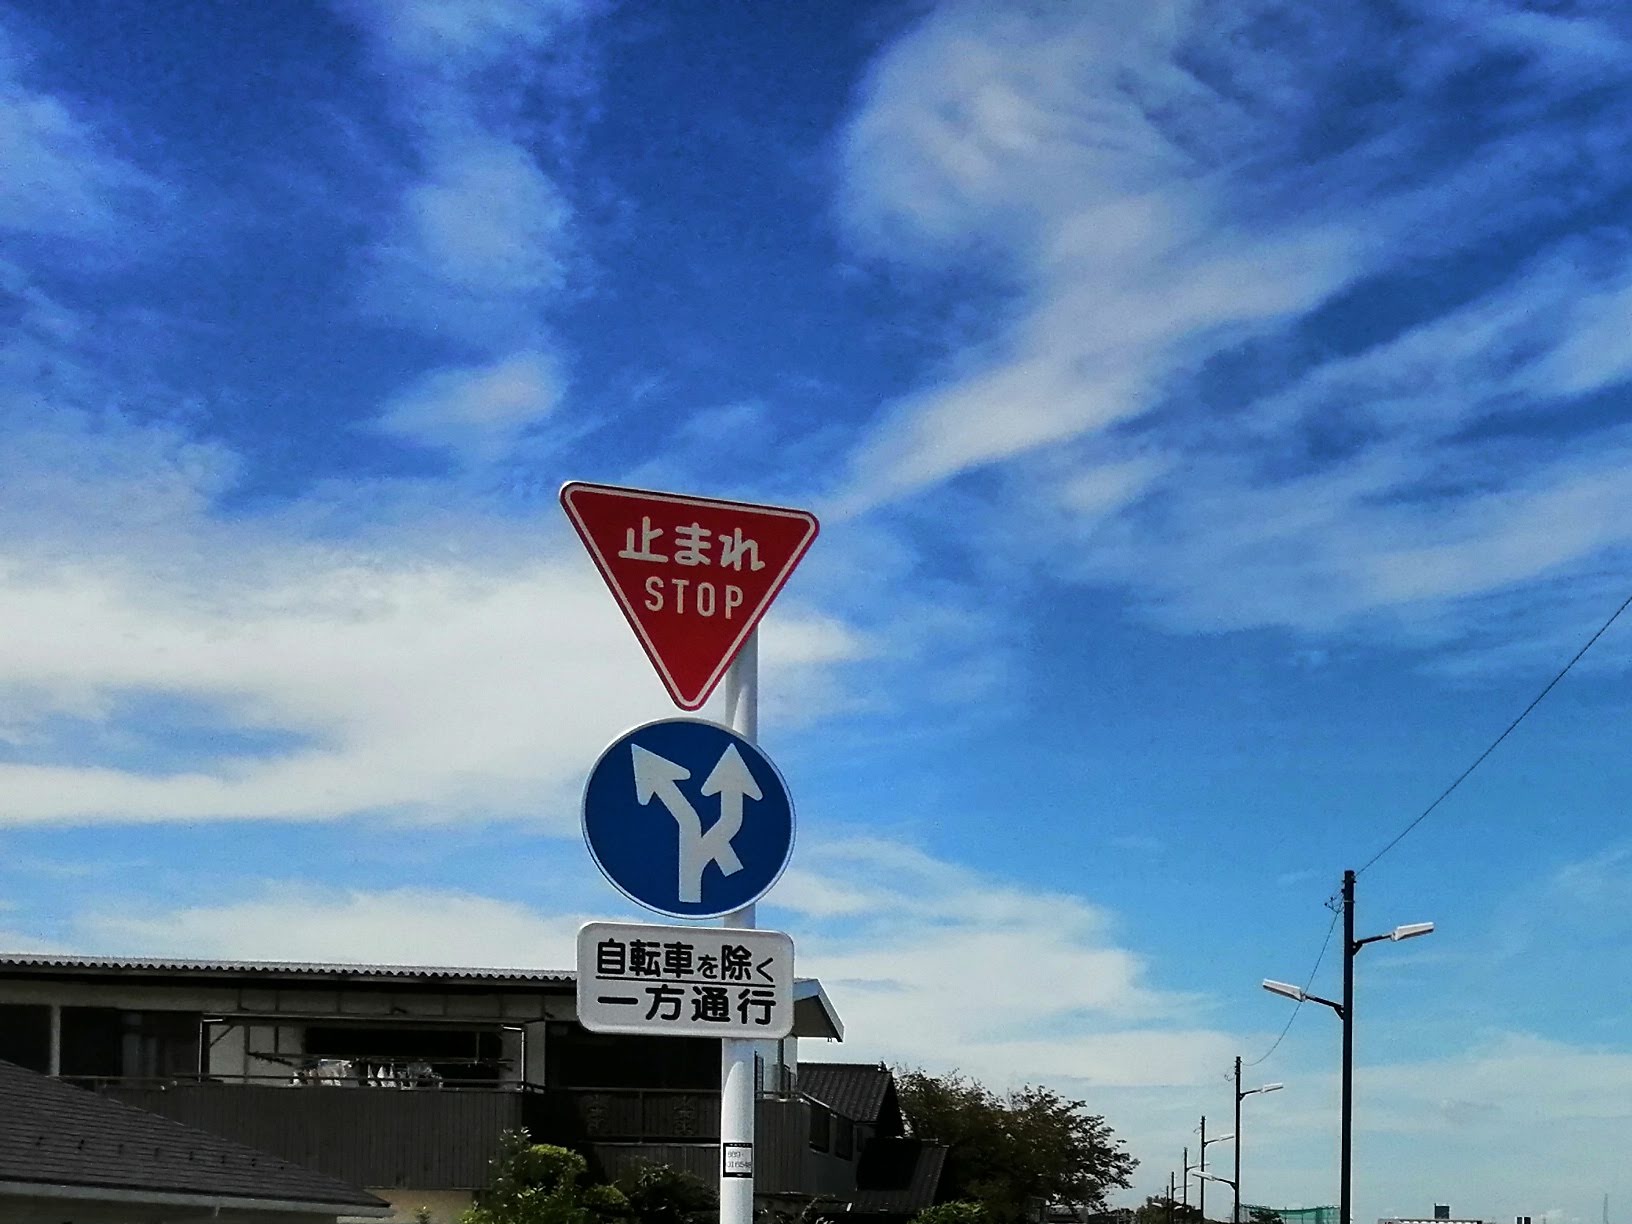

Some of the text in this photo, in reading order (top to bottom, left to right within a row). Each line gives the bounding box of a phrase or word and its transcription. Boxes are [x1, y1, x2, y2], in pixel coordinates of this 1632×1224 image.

[618, 516, 766, 572] 止まれ
[644, 576, 744, 620] STOP
[597, 938, 774, 983] 自転車を除く
[597, 984, 776, 1025] 一方通行
